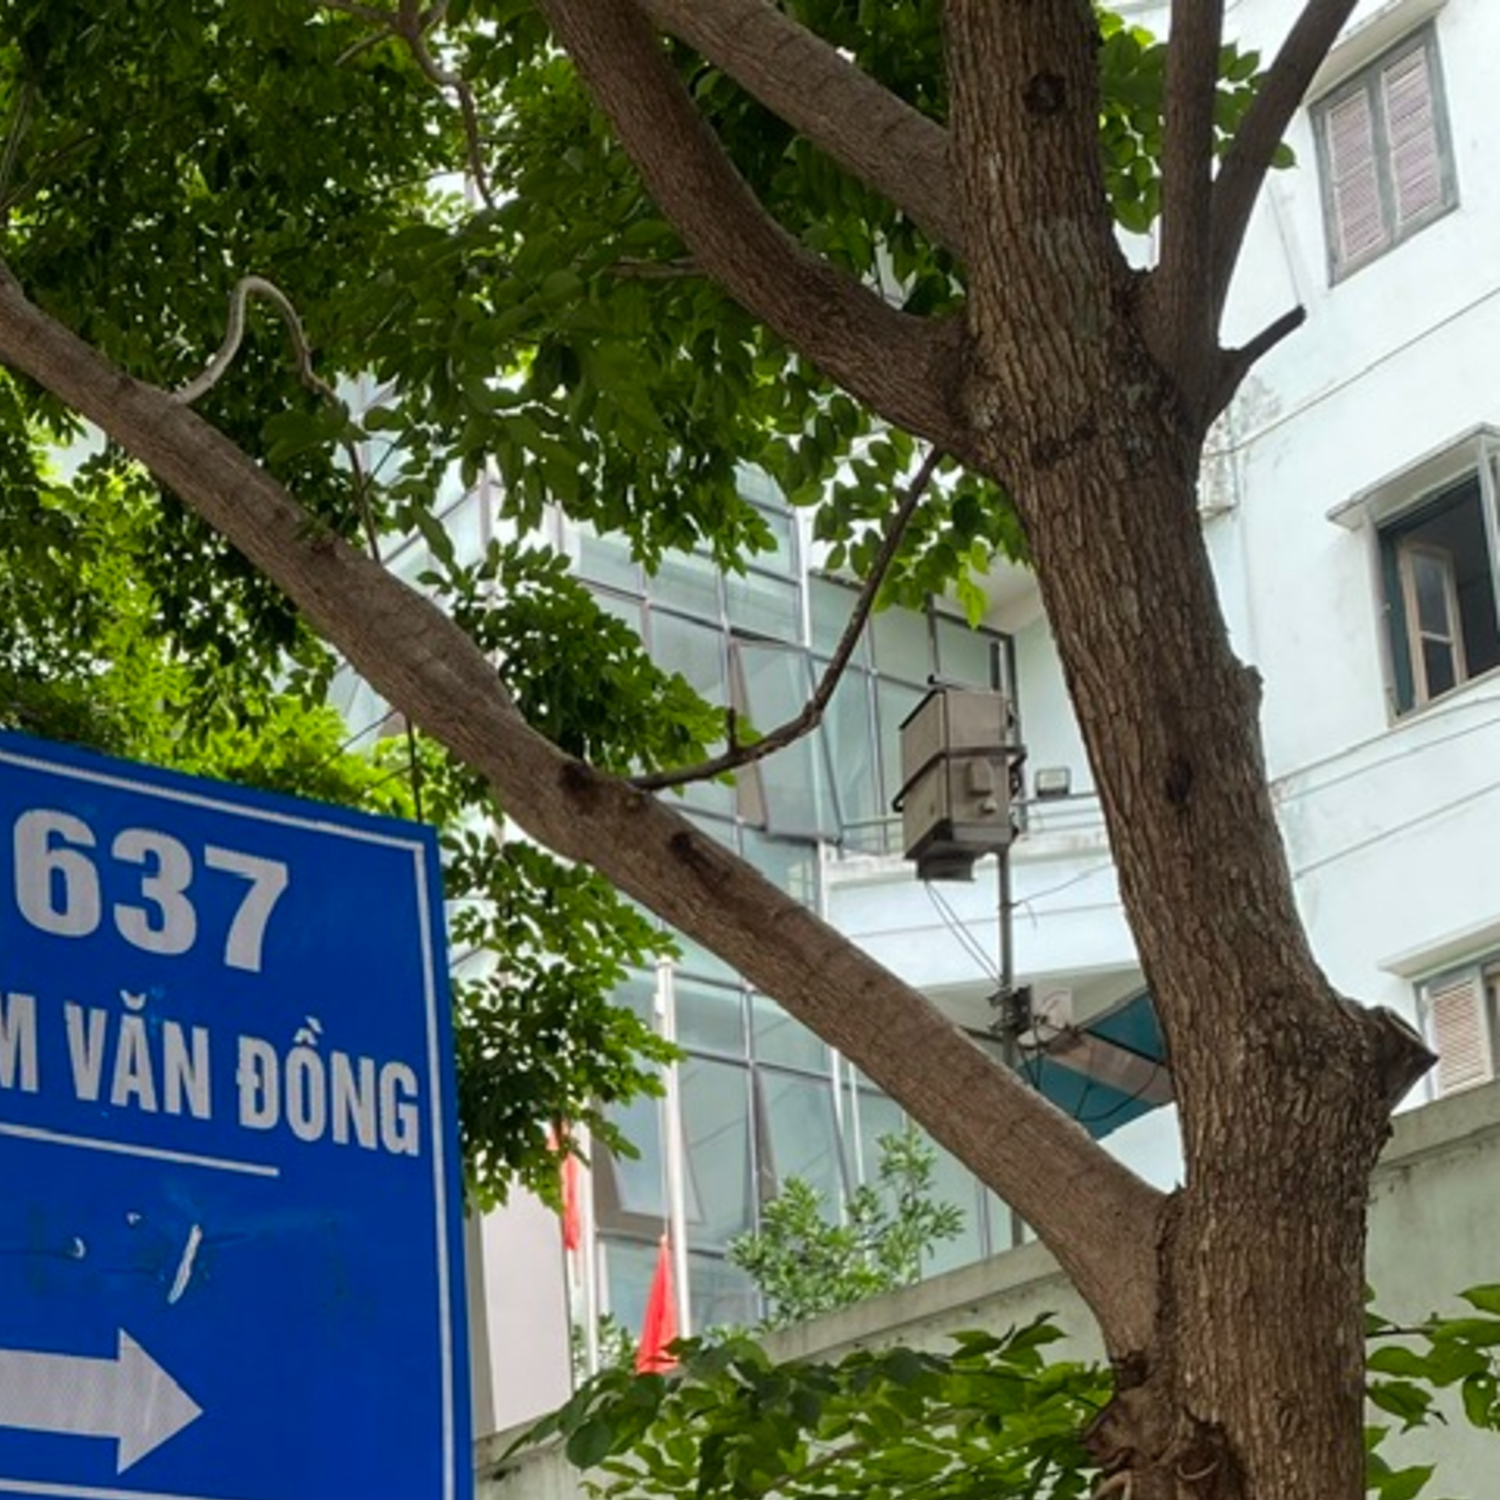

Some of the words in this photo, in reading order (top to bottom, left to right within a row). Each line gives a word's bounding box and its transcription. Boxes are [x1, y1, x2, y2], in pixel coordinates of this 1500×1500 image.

[13, 806, 290, 974] 637
[65, 990, 213, 1122] VĂN
[236, 1014, 420, 1158] ĐỒNG
